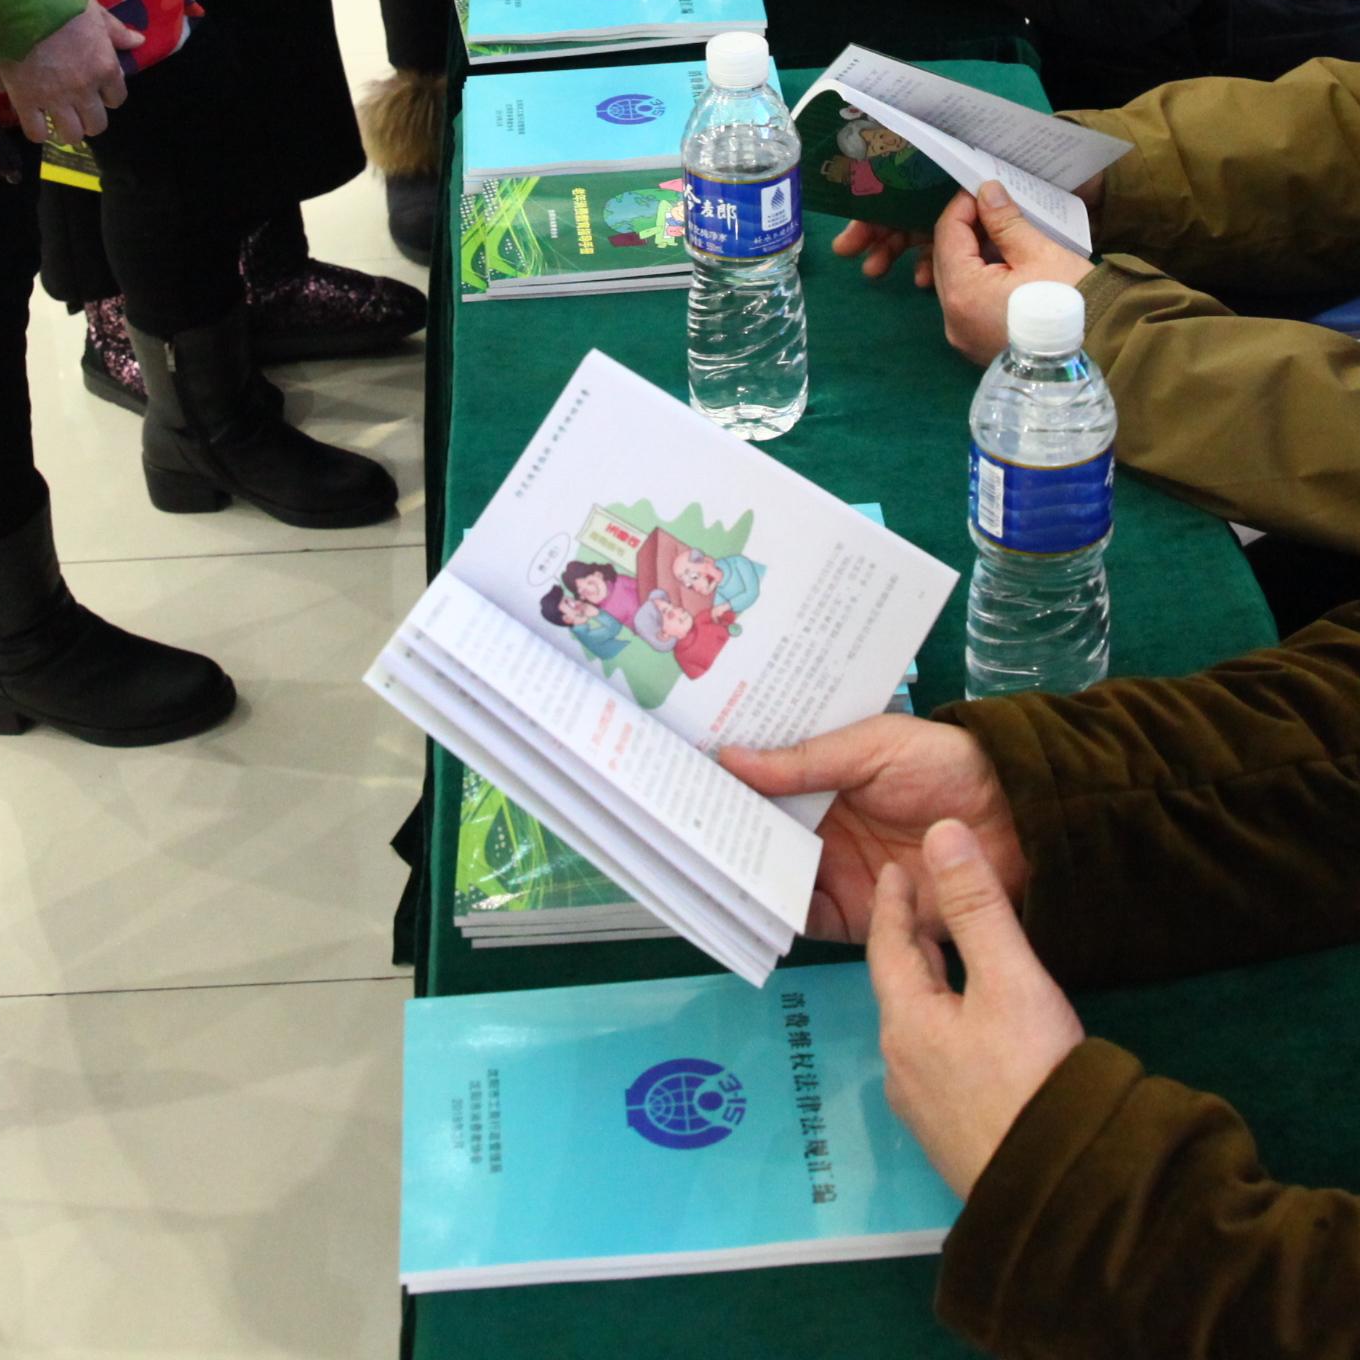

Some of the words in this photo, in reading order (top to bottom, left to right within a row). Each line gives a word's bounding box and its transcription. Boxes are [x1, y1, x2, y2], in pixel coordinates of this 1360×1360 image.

[469, 1080, 483, 1164] 沈阳市消费者协会
[781, 992, 837, 1205] 消费维权法律法规汇编
